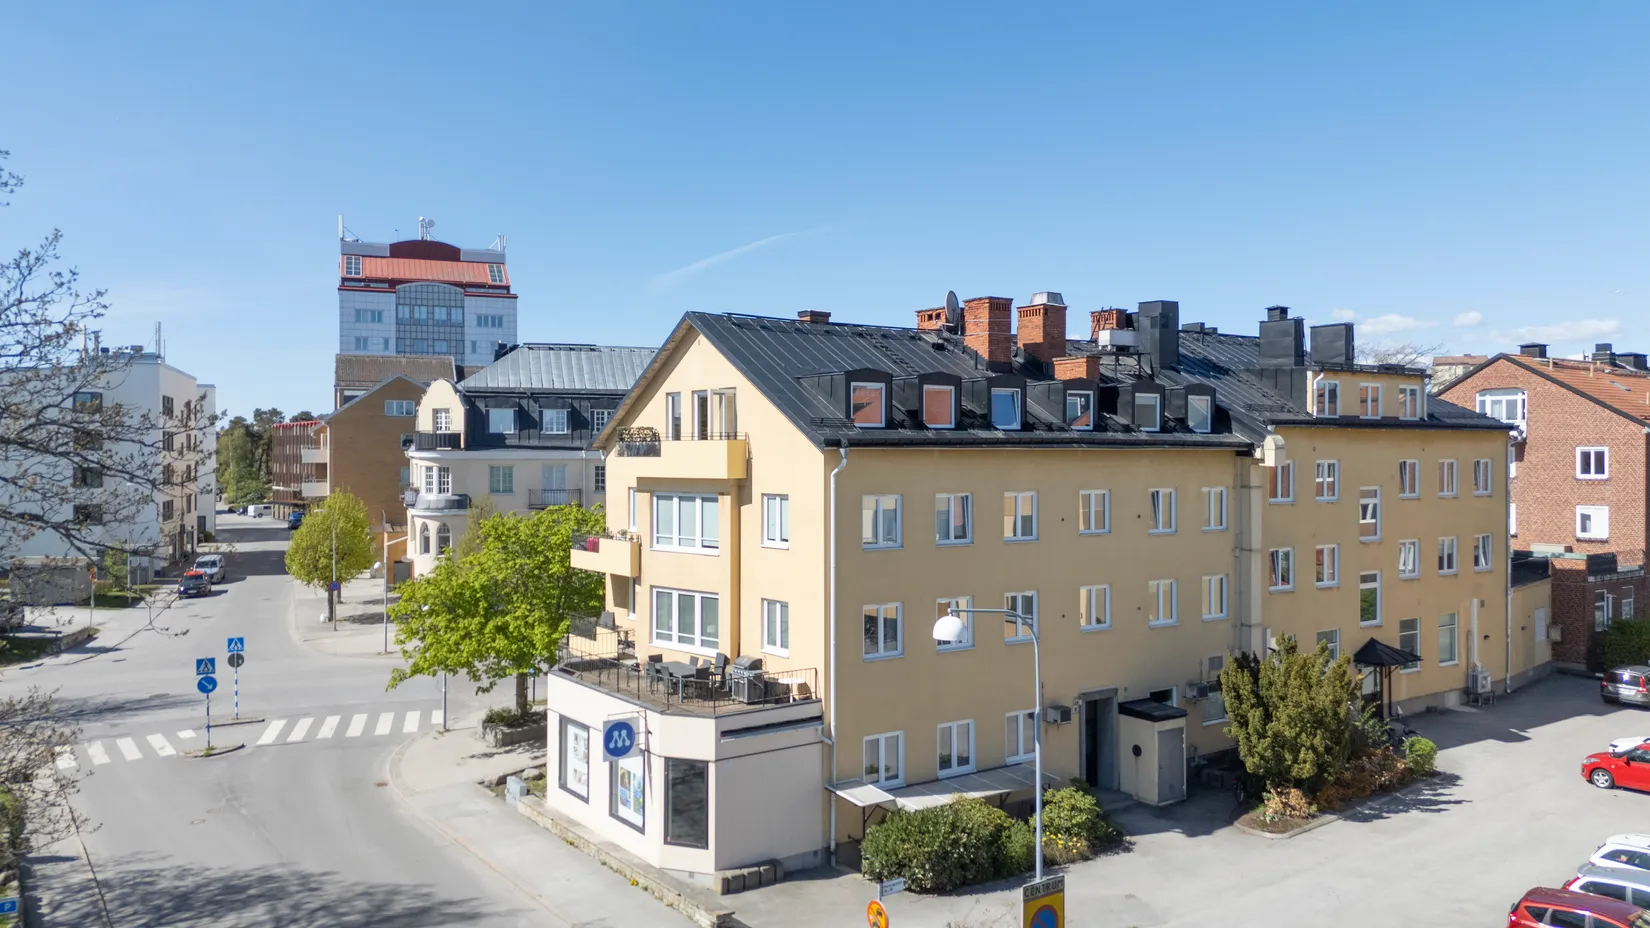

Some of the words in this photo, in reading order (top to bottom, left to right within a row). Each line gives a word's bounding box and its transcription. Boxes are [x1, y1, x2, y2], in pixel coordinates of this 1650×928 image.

[609, 730, 631, 749] M
[1024, 878, 1063, 898] CENTRUM
[4, 902, 12, 912] P
